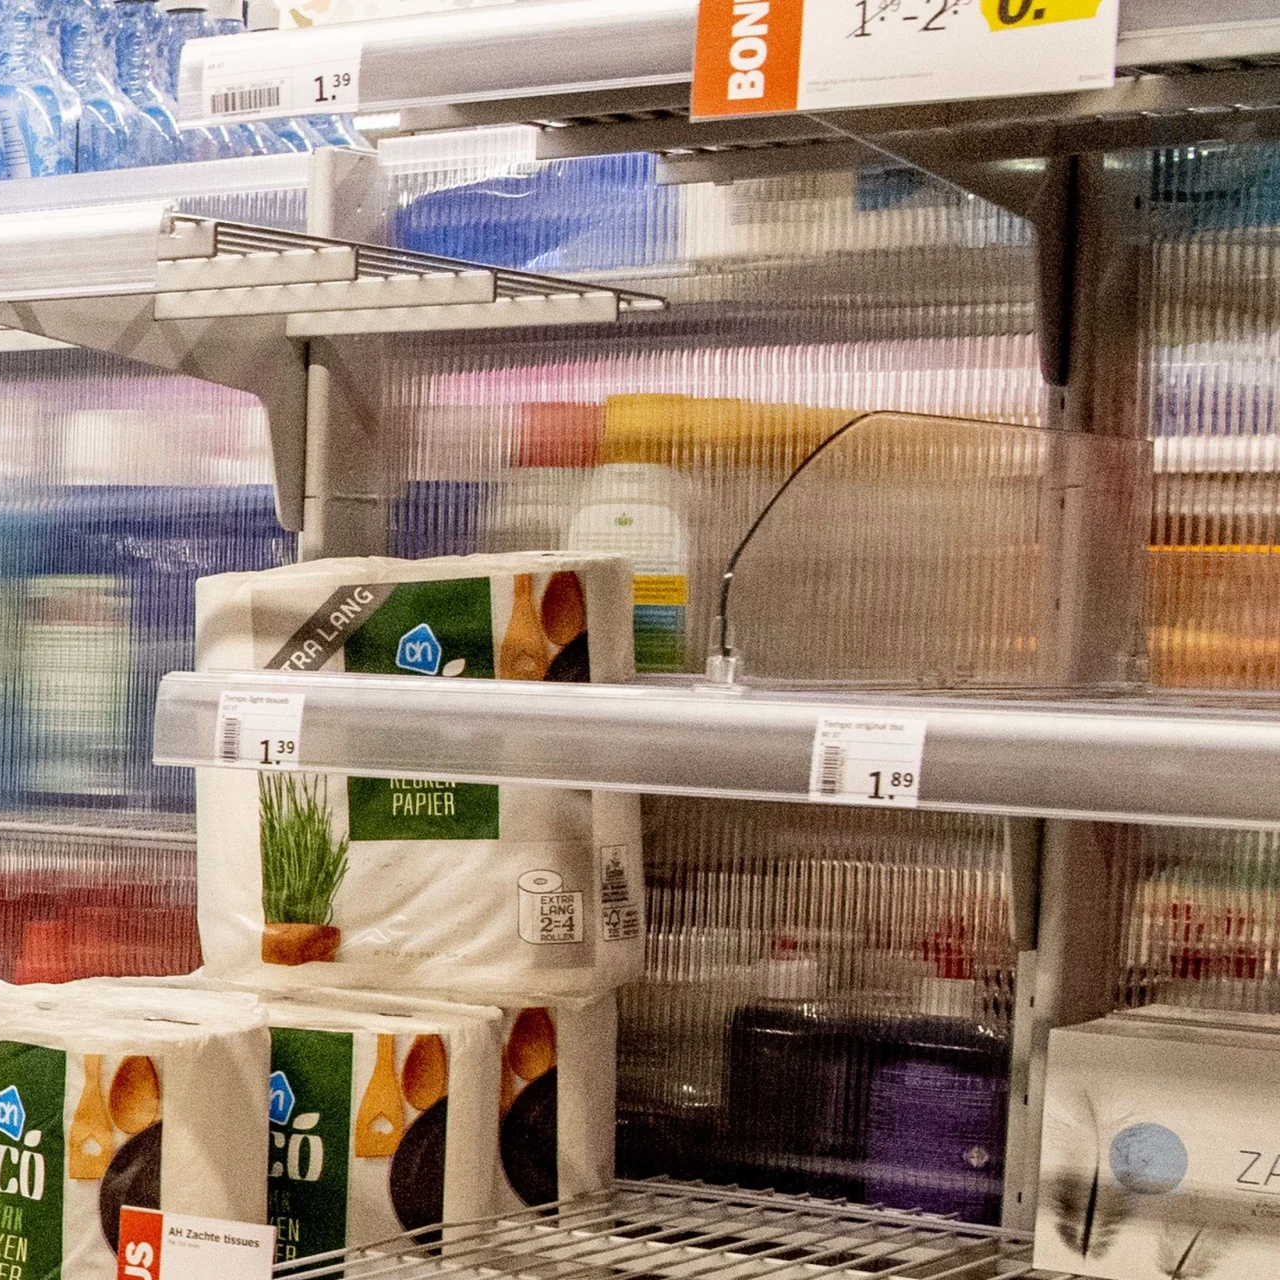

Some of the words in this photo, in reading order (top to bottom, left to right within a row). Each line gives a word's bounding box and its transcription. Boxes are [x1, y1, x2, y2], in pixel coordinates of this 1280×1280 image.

[728, 0, 769, 100] BON
[313, 72, 351, 103] 1.39
[318, 586, 375, 642] LANG
[259, 739, 295, 765] 1.39
[868, 771, 914, 800] 1.89
[392, 792, 455, 817] PAPIER
[540, 895, 575, 905] EXTRA
[540, 905, 575, 916] LANG
[540, 916, 575, 932] 2=4
[540, 932, 575, 942] ROLLEN
[168, 1226, 183, 1237] AH
[186, 1228, 221, 1244] Zachte
[223, 1234, 260, 1248] tissues
